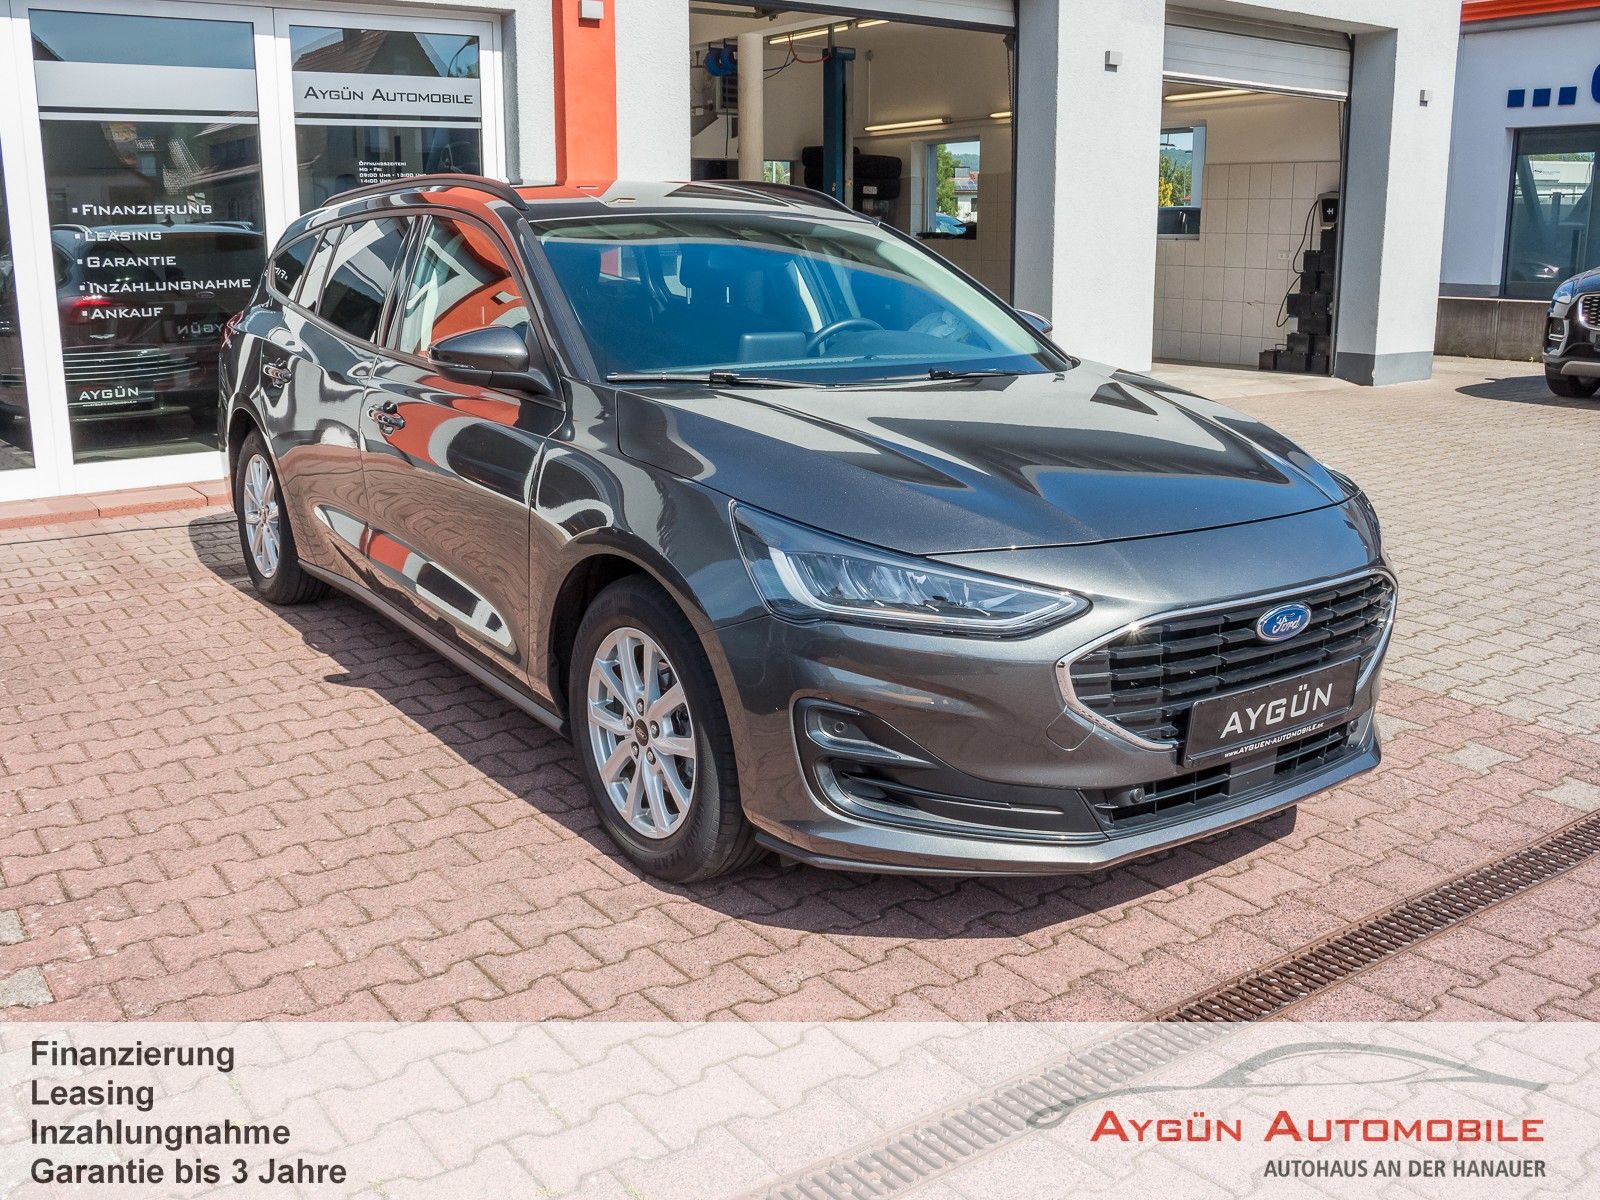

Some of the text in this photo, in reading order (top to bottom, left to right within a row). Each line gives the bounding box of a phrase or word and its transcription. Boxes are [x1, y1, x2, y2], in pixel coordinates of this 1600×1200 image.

[303, 86, 474, 105] AYGÜN AUTOMOBILE
[82, 204, 213, 216] FINANZIERUNG
[84, 230, 162, 242] LEASING
[87, 256, 177, 268] GARANTIE
[88, 278, 252, 294] INZAHLUNGNAHME
[91, 307, 164, 320] ANKAUF
[79, 385, 139, 401] AYGÜN
[1271, 612, 1303, 634] Ford
[1219, 682, 1333, 739] AYGÜN
